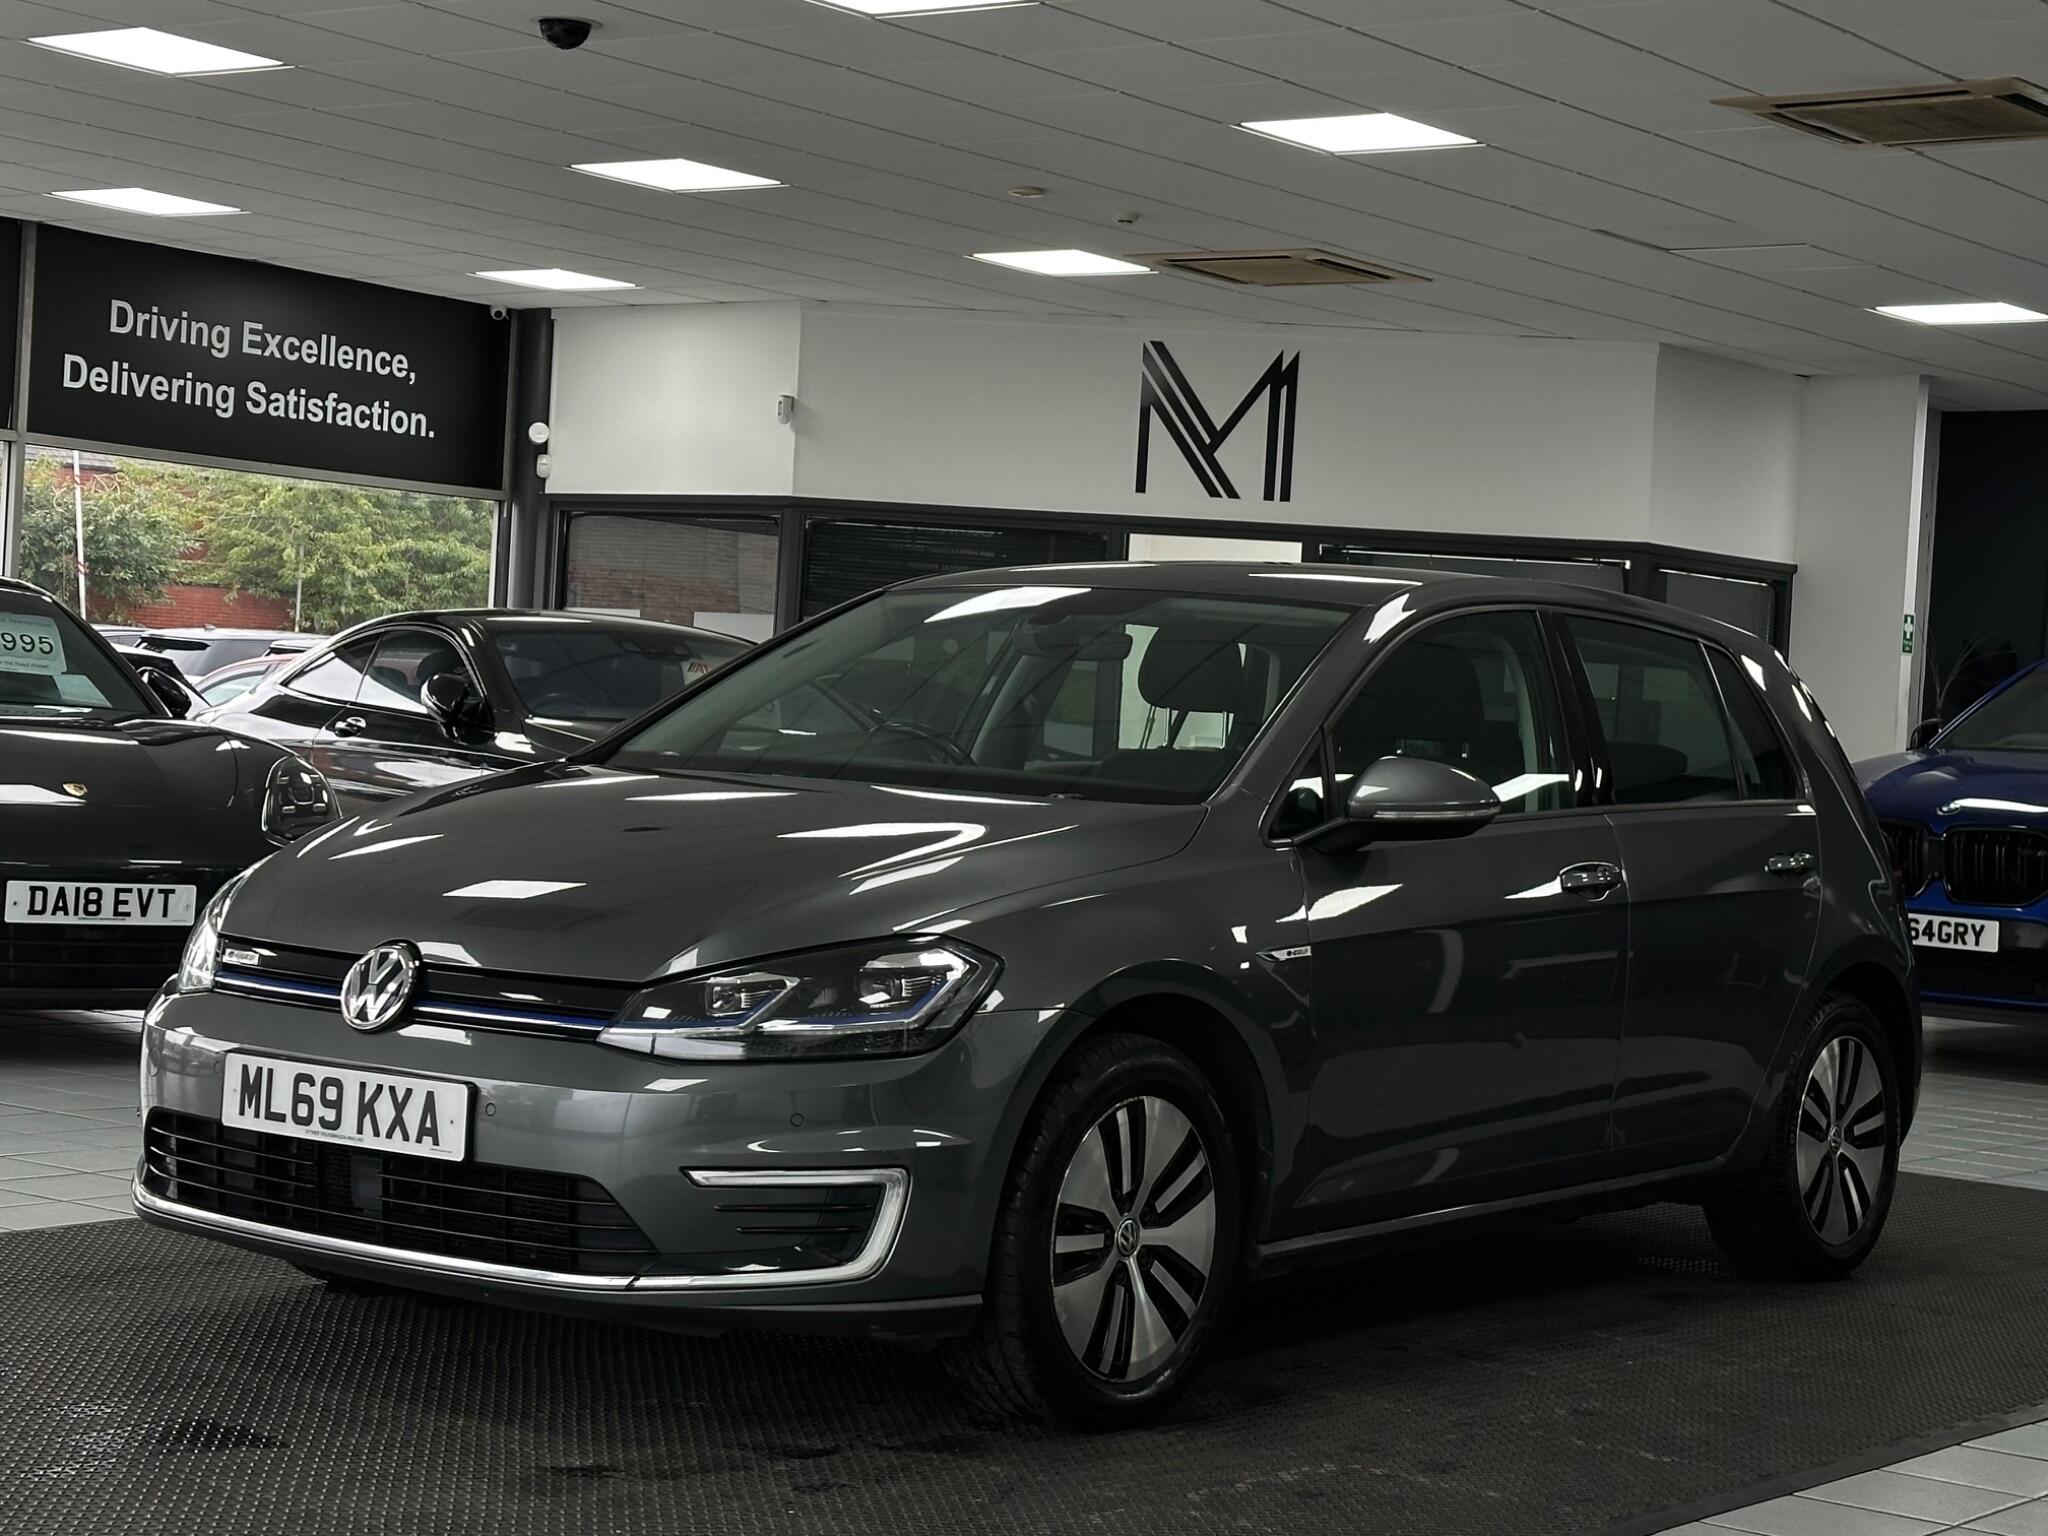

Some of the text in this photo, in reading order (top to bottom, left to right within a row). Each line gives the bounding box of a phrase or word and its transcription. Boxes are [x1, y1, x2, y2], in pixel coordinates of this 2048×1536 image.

[109, 299, 416, 385] Driving Excellence,
[62, 353, 435, 438] Delivering Satisfaction.
[0, 632, 53, 654] 995
[27, 885, 176, 918] DA18 EVT
[238, 1063, 441, 1147] ML69 KXA
